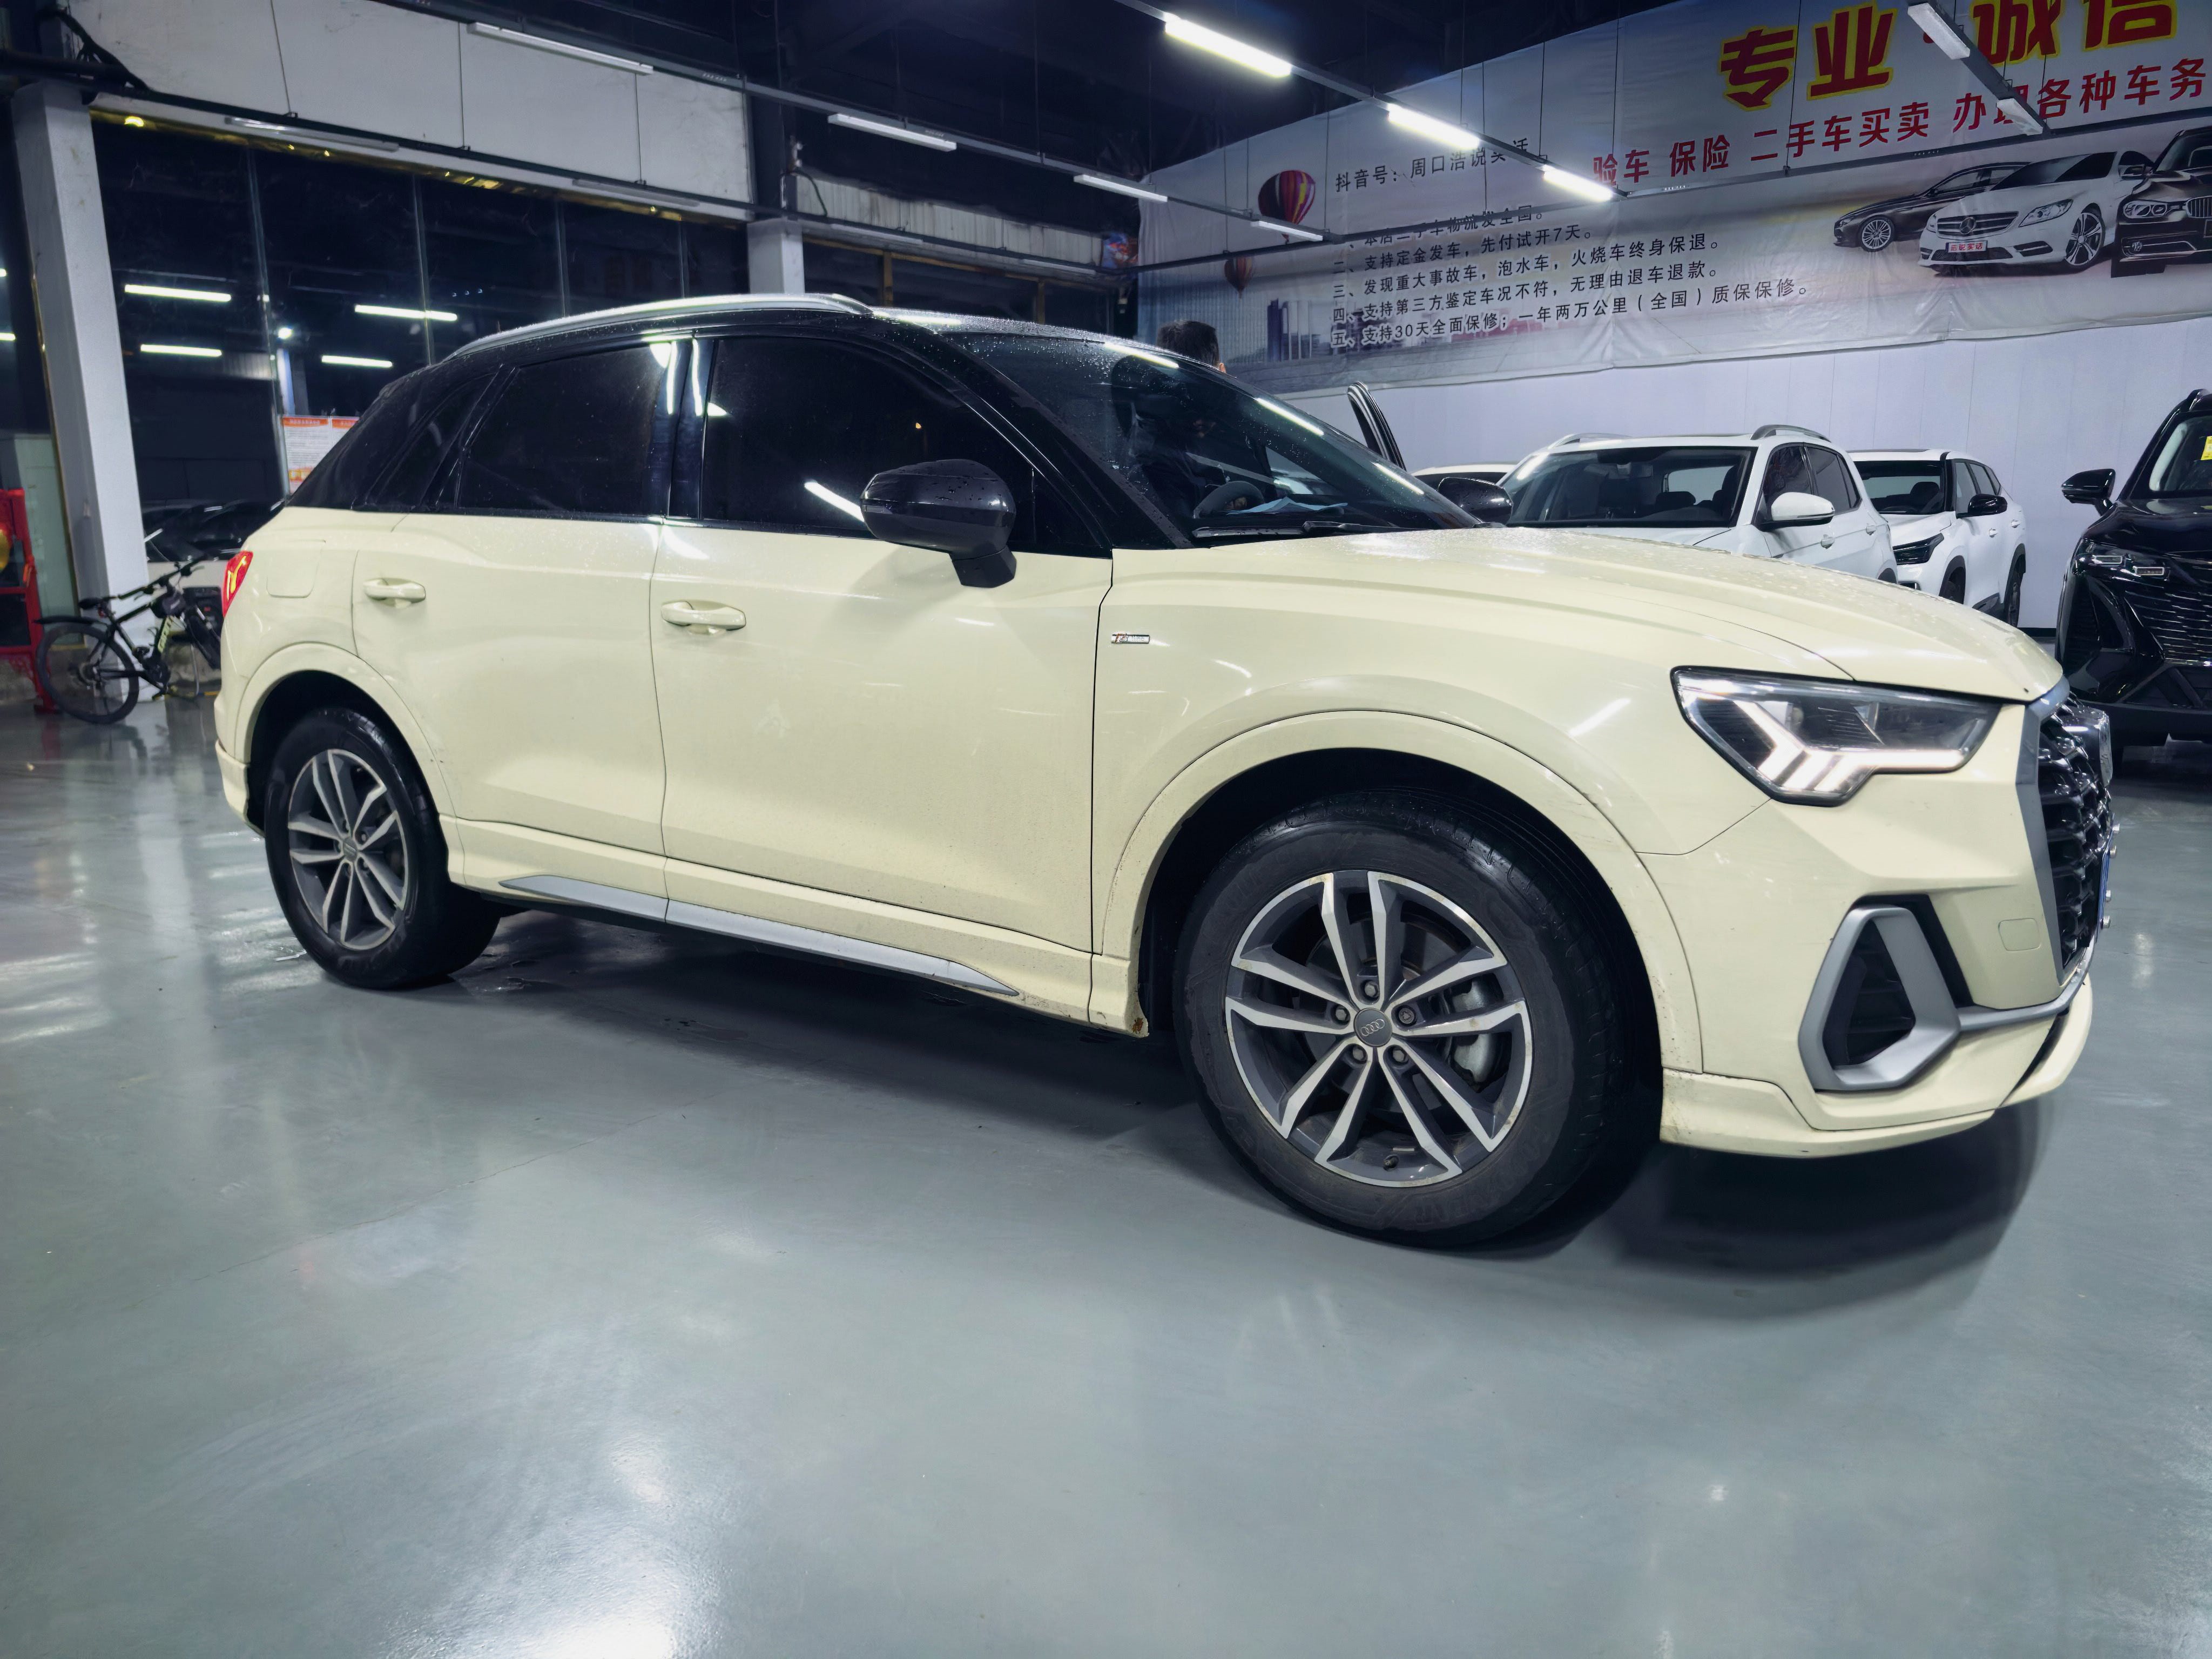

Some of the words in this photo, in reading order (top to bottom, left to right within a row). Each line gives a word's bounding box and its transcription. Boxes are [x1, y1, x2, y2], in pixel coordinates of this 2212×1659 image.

[1593, 149, 1649, 185] 验车
[1669, 134, 1730, 177] 保险
[1750, 102, 1929, 161] 二手车买卖
